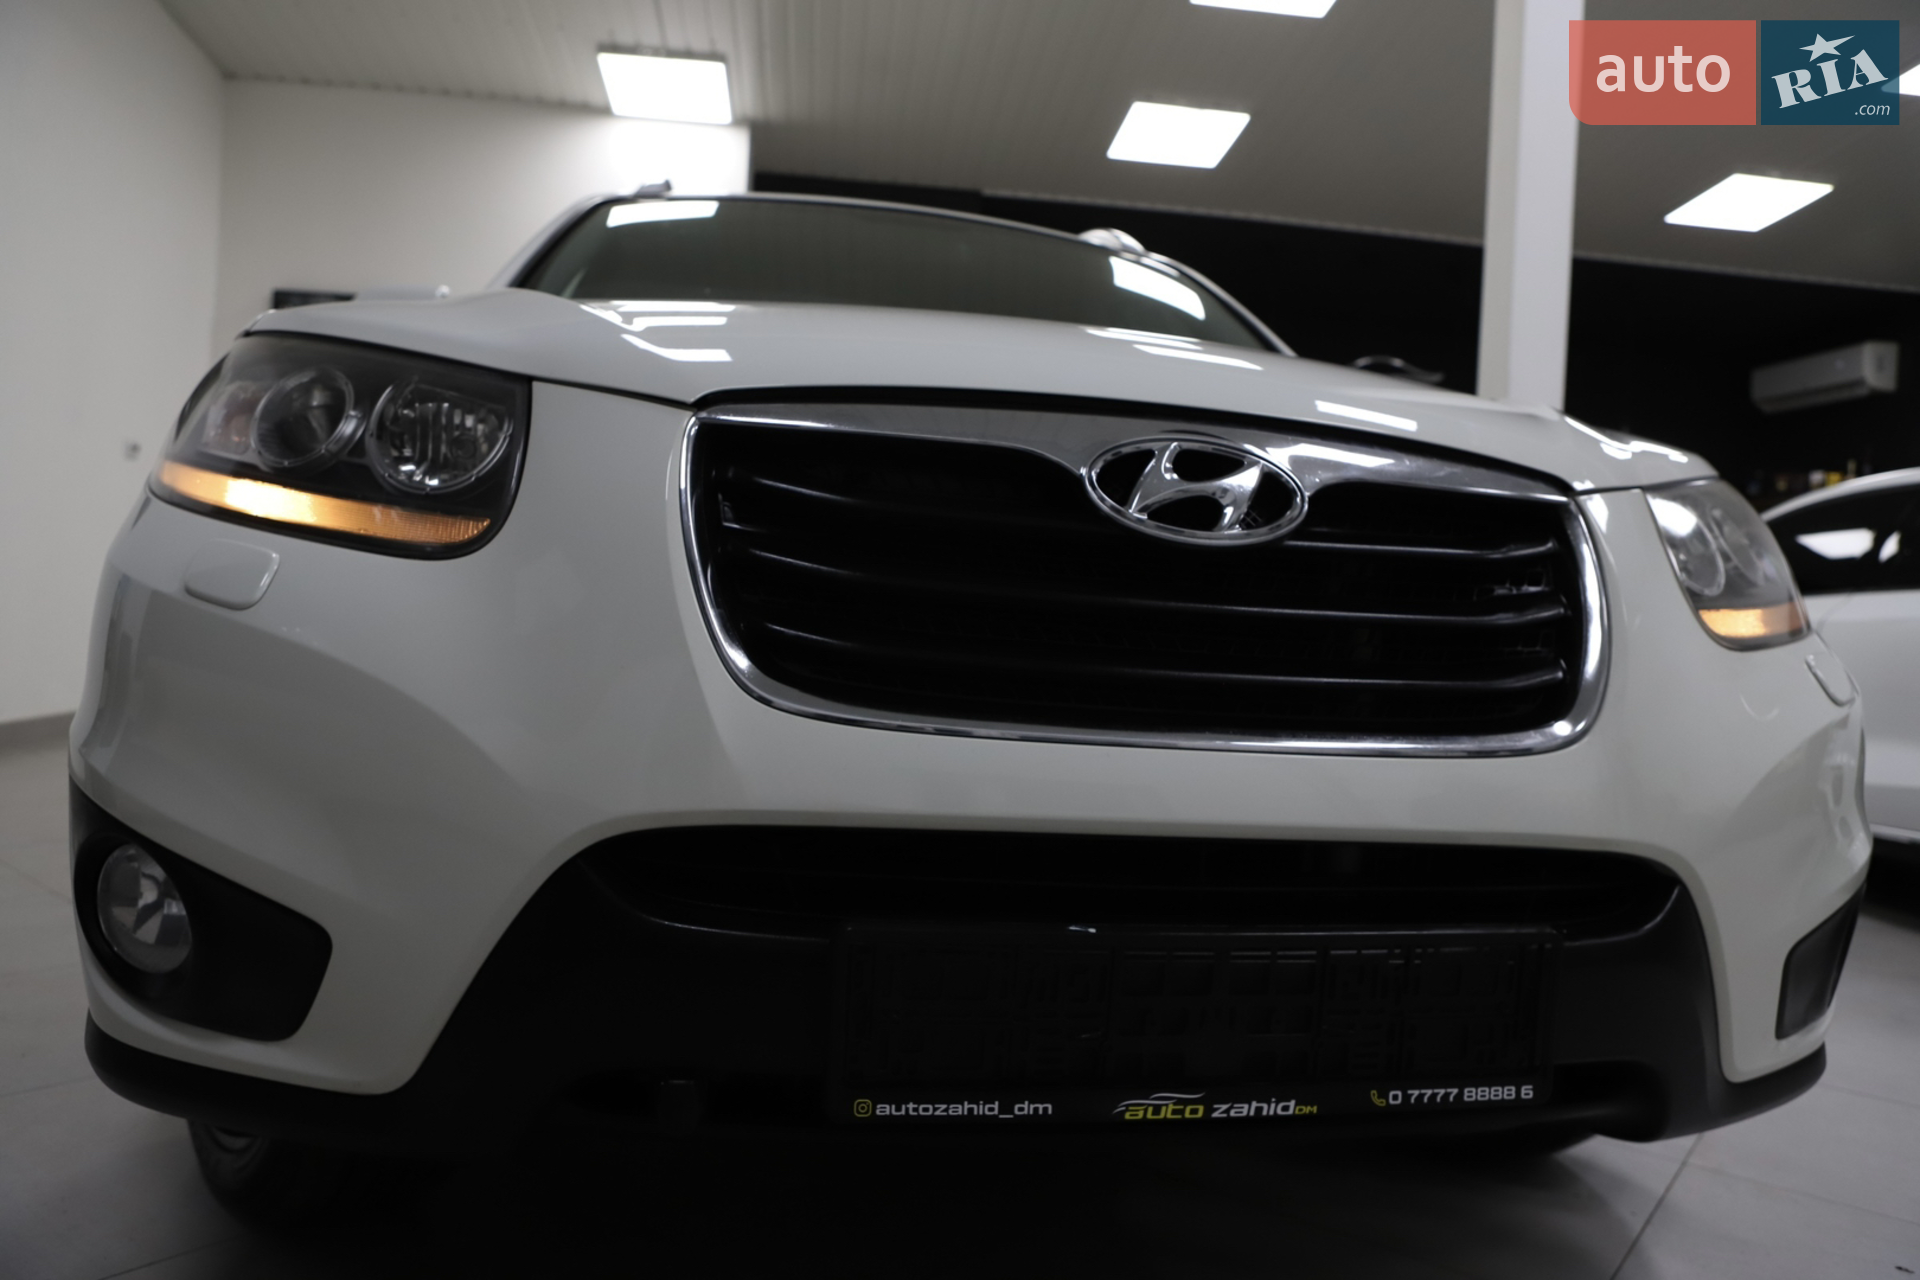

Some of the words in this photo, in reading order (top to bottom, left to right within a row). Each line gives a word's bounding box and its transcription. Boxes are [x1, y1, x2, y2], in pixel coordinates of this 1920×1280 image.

[1407, 1088, 1459, 1104] 7777
[1463, 1085, 1516, 1102] 8888
[1520, 1085, 1534, 1099] 6
[875, 1100, 1053, 1119] autozahid_dm
[1124, 1102, 1205, 1120] auto
